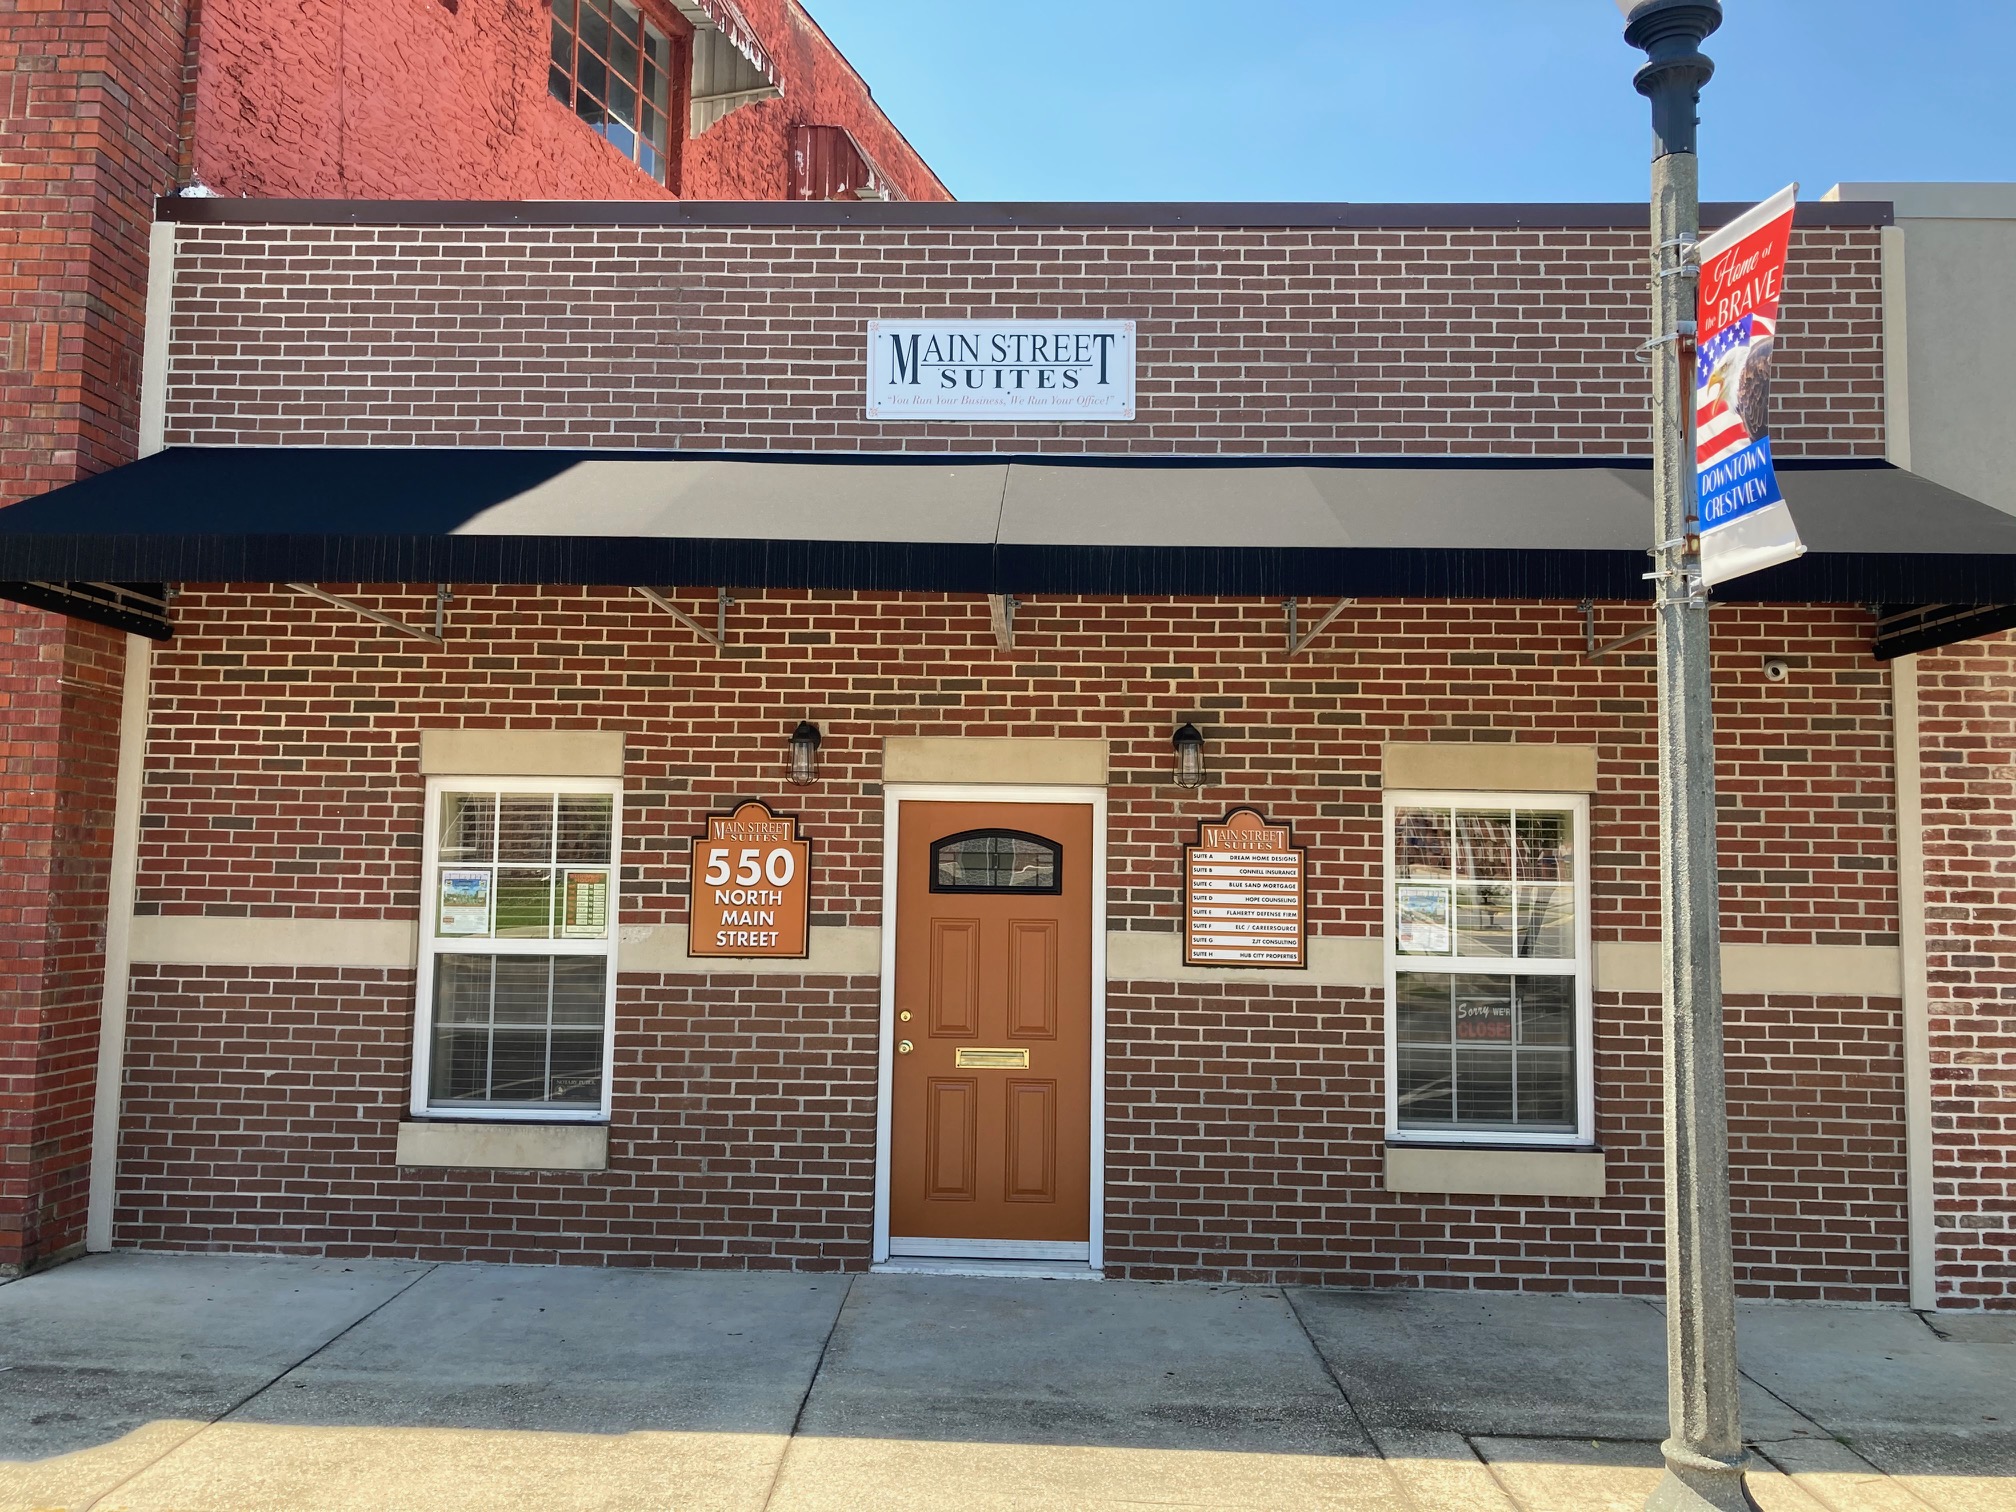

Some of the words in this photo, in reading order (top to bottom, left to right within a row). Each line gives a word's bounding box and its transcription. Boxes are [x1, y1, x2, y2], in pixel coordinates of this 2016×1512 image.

[1704, 246, 1760, 306] Home
[1761, 240, 1774, 259] of
[1705, 315, 1716, 331] the
[1717, 265, 1779, 329] BRAVE
[889, 333, 981, 385] MAIN
[991, 333, 1115, 385] STREET
[940, 368, 1079, 390] SUITES
[912, 395, 932, 405] Run
[936, 395, 959, 405] Your
[961, 395, 1006, 407] Business,
[1010, 395, 1026, 405] We
[1028, 395, 1048, 405] Run
[1051, 395, 1074, 405] Your
[1702, 443, 1767, 497] DOWNTOWN
[1705, 473, 1767, 522] CRESTVIEW
[713, 821, 745, 840] MAIN
[748, 821, 791, 841] STREET
[730, 834, 778, 842] SUITES
[1206, 828, 1239, 848] MAIN
[1241, 829, 1285, 849] STREET
[1224, 842, 1273, 850] SUITES
[704, 847, 795, 887] 550
[714, 889, 783, 906] NORTH
[720, 910, 774, 926] MAIN
[716, 930, 779, 947] STREET
[1458, 1003, 1490, 1019] Sorry
